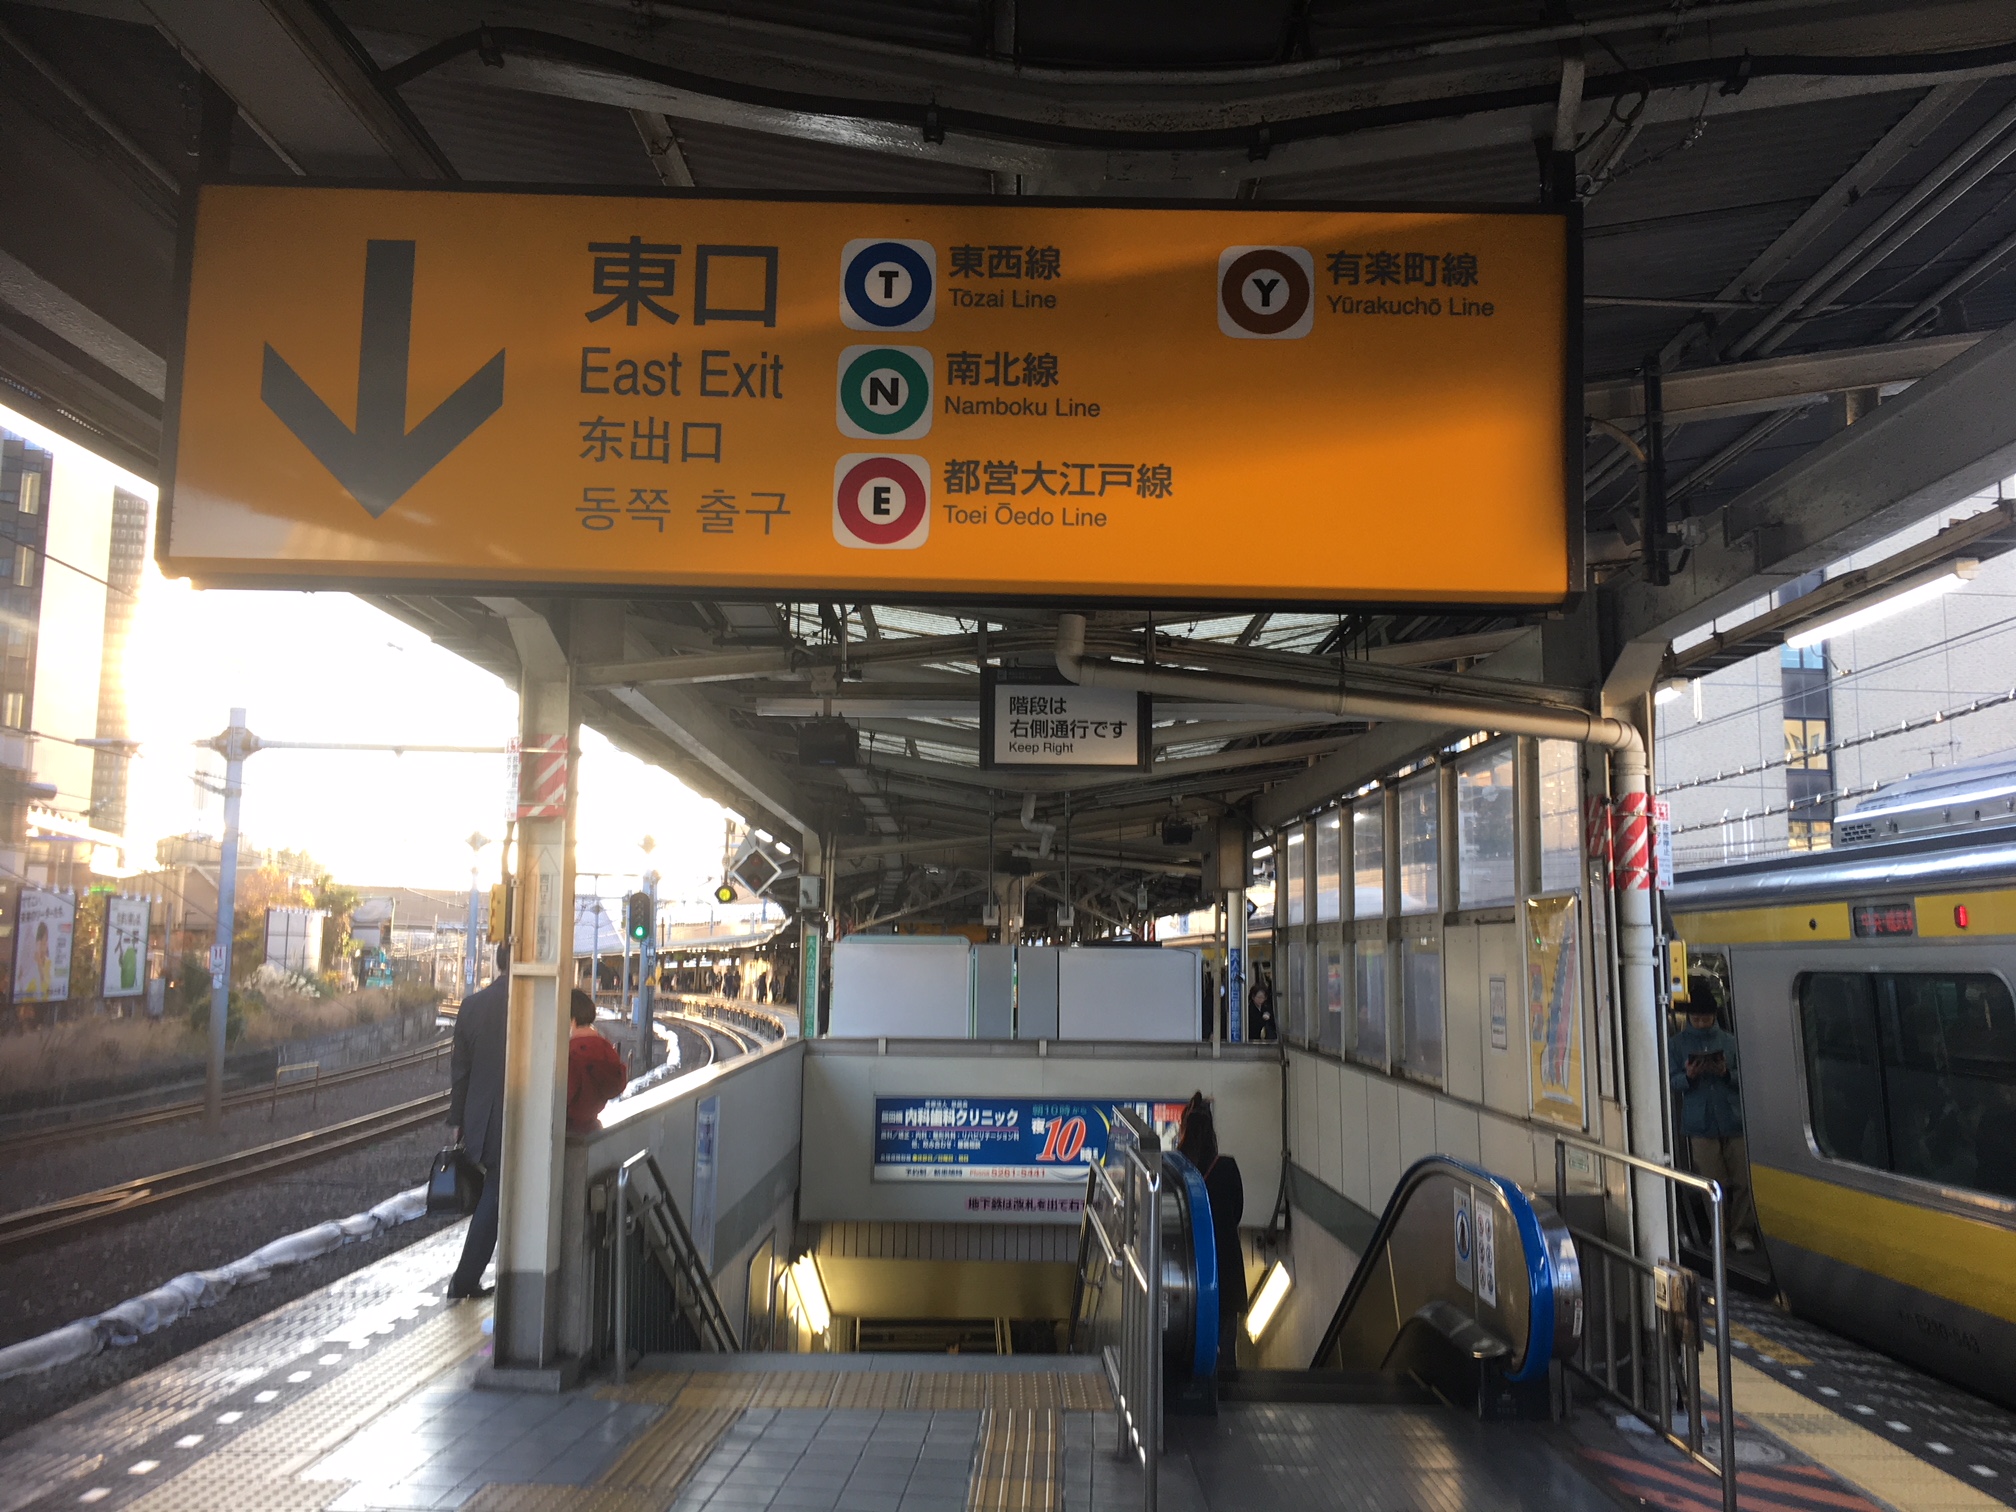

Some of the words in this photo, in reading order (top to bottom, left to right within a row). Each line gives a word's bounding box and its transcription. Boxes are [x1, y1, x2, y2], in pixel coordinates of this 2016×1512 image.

[949, 245, 1062, 281] 東西線
[1326, 250, 1479, 287] 有楽町線
[585, 236, 779, 328] 東口
[879, 270, 899, 299] T
[1252, 278, 1280, 307] Y
[948, 288, 1005, 308] Tōzai
[1012, 289, 1057, 309] Line
[1326, 295, 1442, 316] Yūrakuchō
[1449, 297, 1495, 317] Line
[580, 346, 683, 397] East
[700, 349, 784, 399] Exit
[946, 350, 1060, 388] 南北線
[869, 377, 900, 406] N
[944, 395, 1048, 417] Namboku
[1055, 397, 1101, 418] Line
[578, 415, 723, 464] 东出口
[943, 458, 1174, 499] 都営大江戸線
[575, 487, 672, 533] 동쪽
[696, 489, 791, 535] 출구
[873, 486, 891, 516] E
[943, 504, 988, 524] Toei
[995, 503, 1055, 526] Ōedo
[1062, 506, 1108, 527] Line
[1009, 696, 1068, 716] 階段は
[1010, 719, 1128, 739] 右側通行です
[1009, 741, 1040, 755] Keep
[1043, 742, 1074, 756] Right
